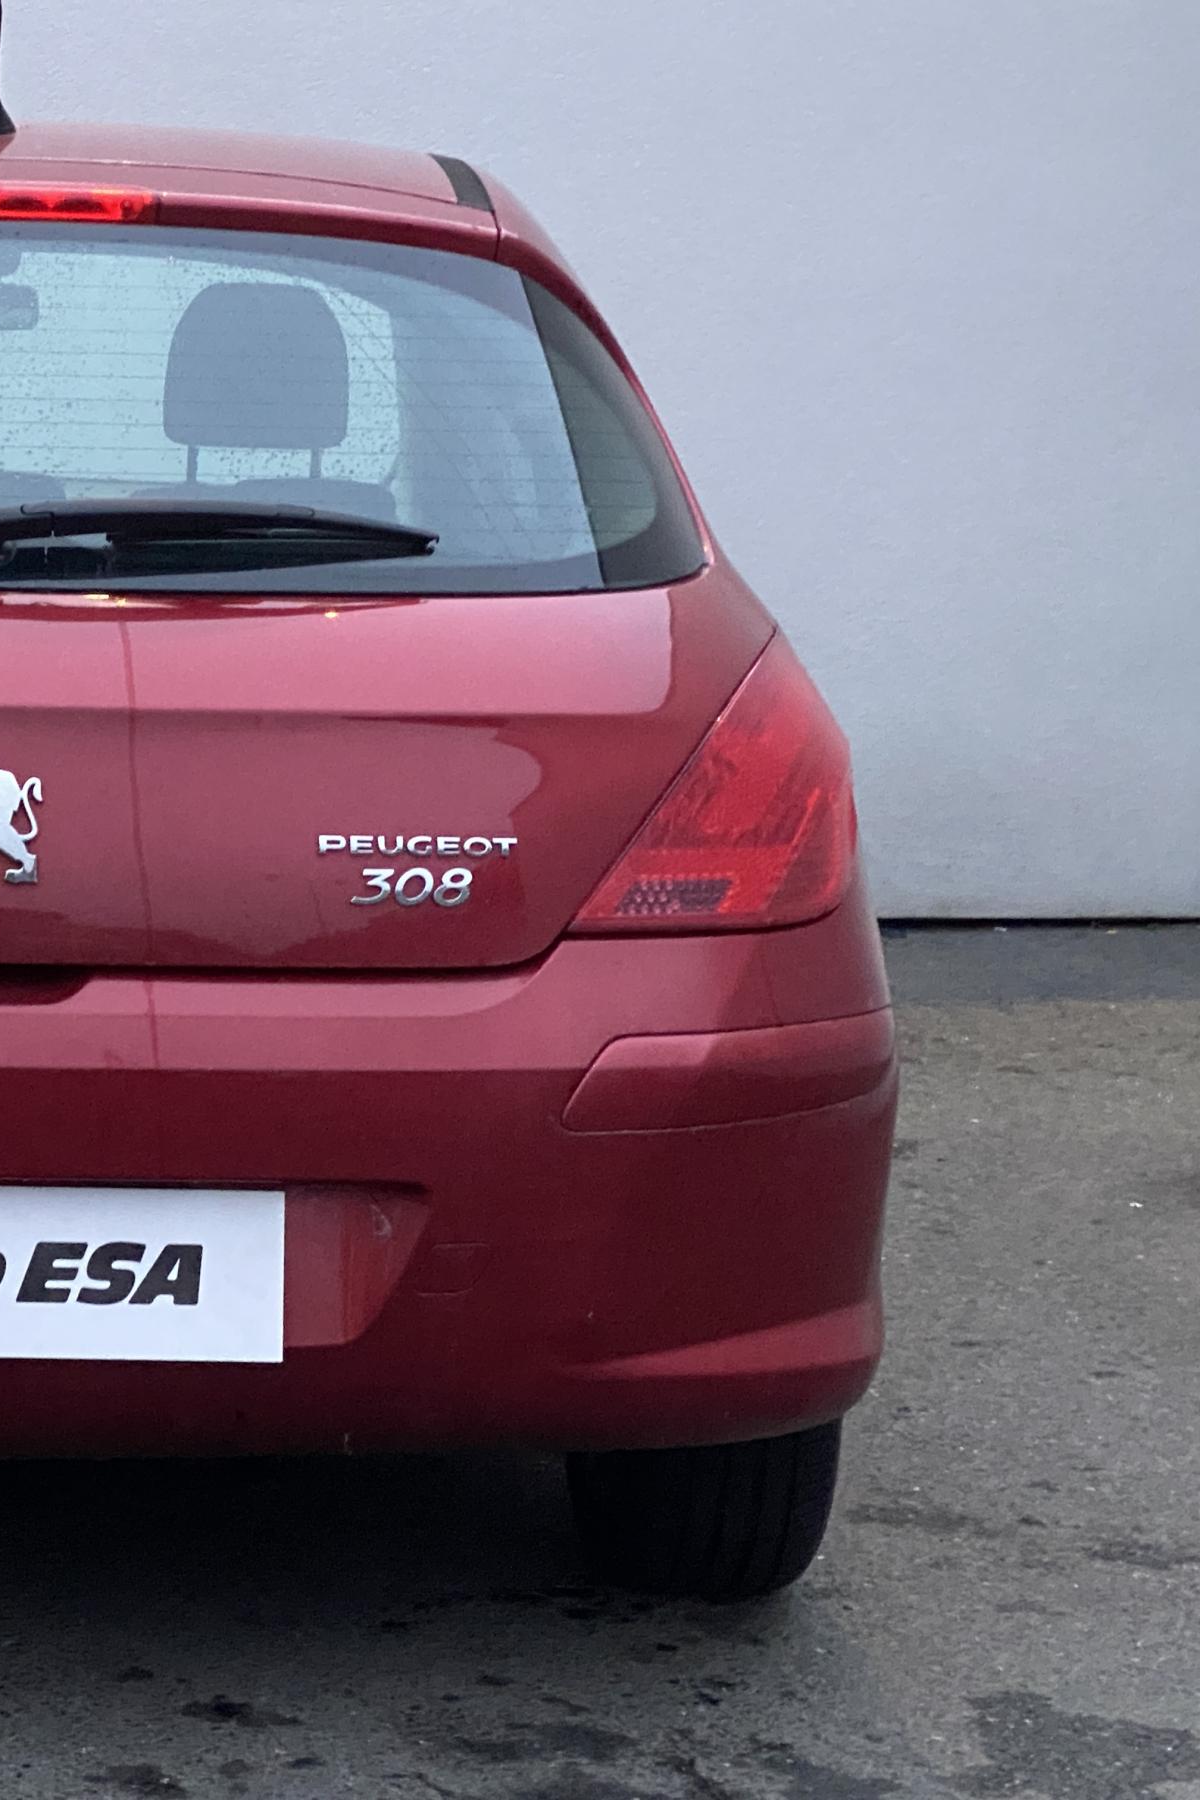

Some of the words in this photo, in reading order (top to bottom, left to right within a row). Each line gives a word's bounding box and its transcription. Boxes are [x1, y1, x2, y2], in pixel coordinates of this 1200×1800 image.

[317, 834, 519, 857] PEUGEOT
[350, 867, 474, 907] 308
[15, 1240, 204, 1306] ESA
